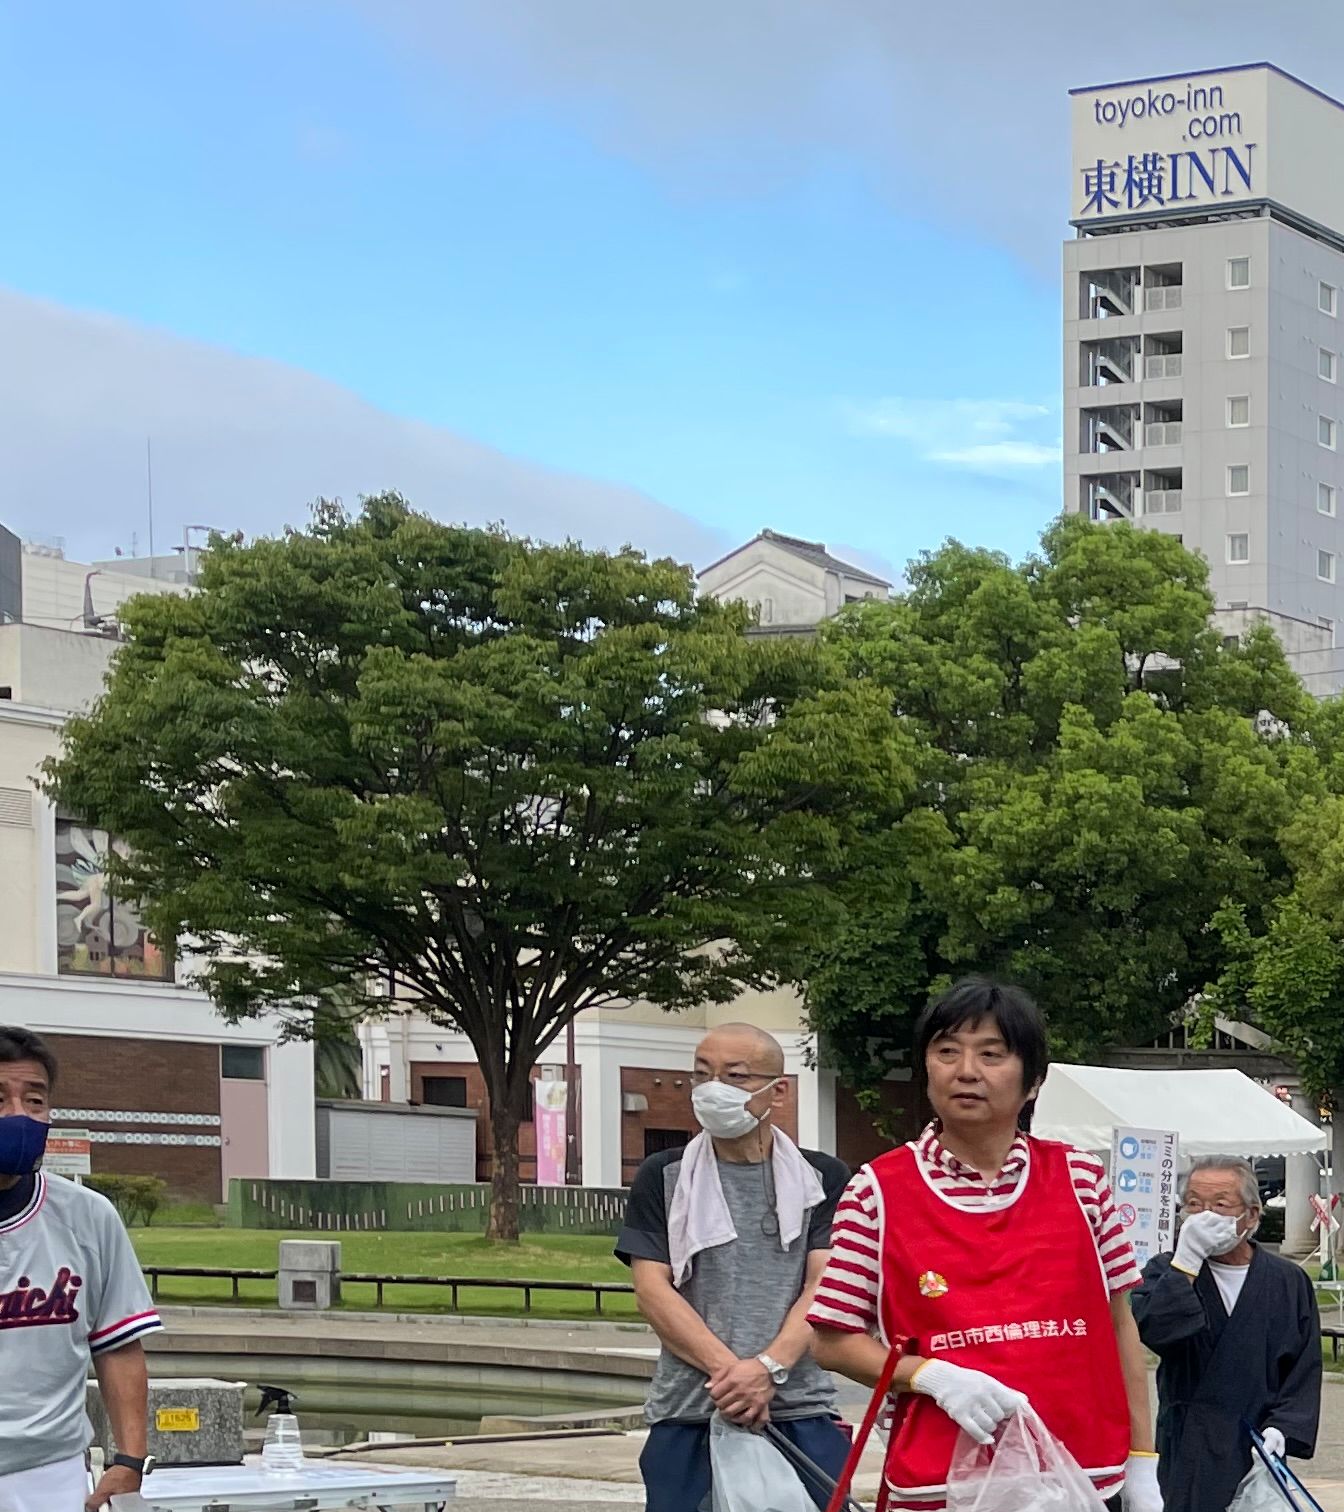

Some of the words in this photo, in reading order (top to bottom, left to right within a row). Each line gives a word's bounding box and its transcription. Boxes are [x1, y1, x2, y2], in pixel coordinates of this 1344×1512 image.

[1094, 82, 1225, 129] toyoko-inn
[1182, 111, 1243, 142] .com
[1080, 142, 1258, 215] 東横INN
[930, 1318, 1088, 1352] 四日市西倫理法人会
